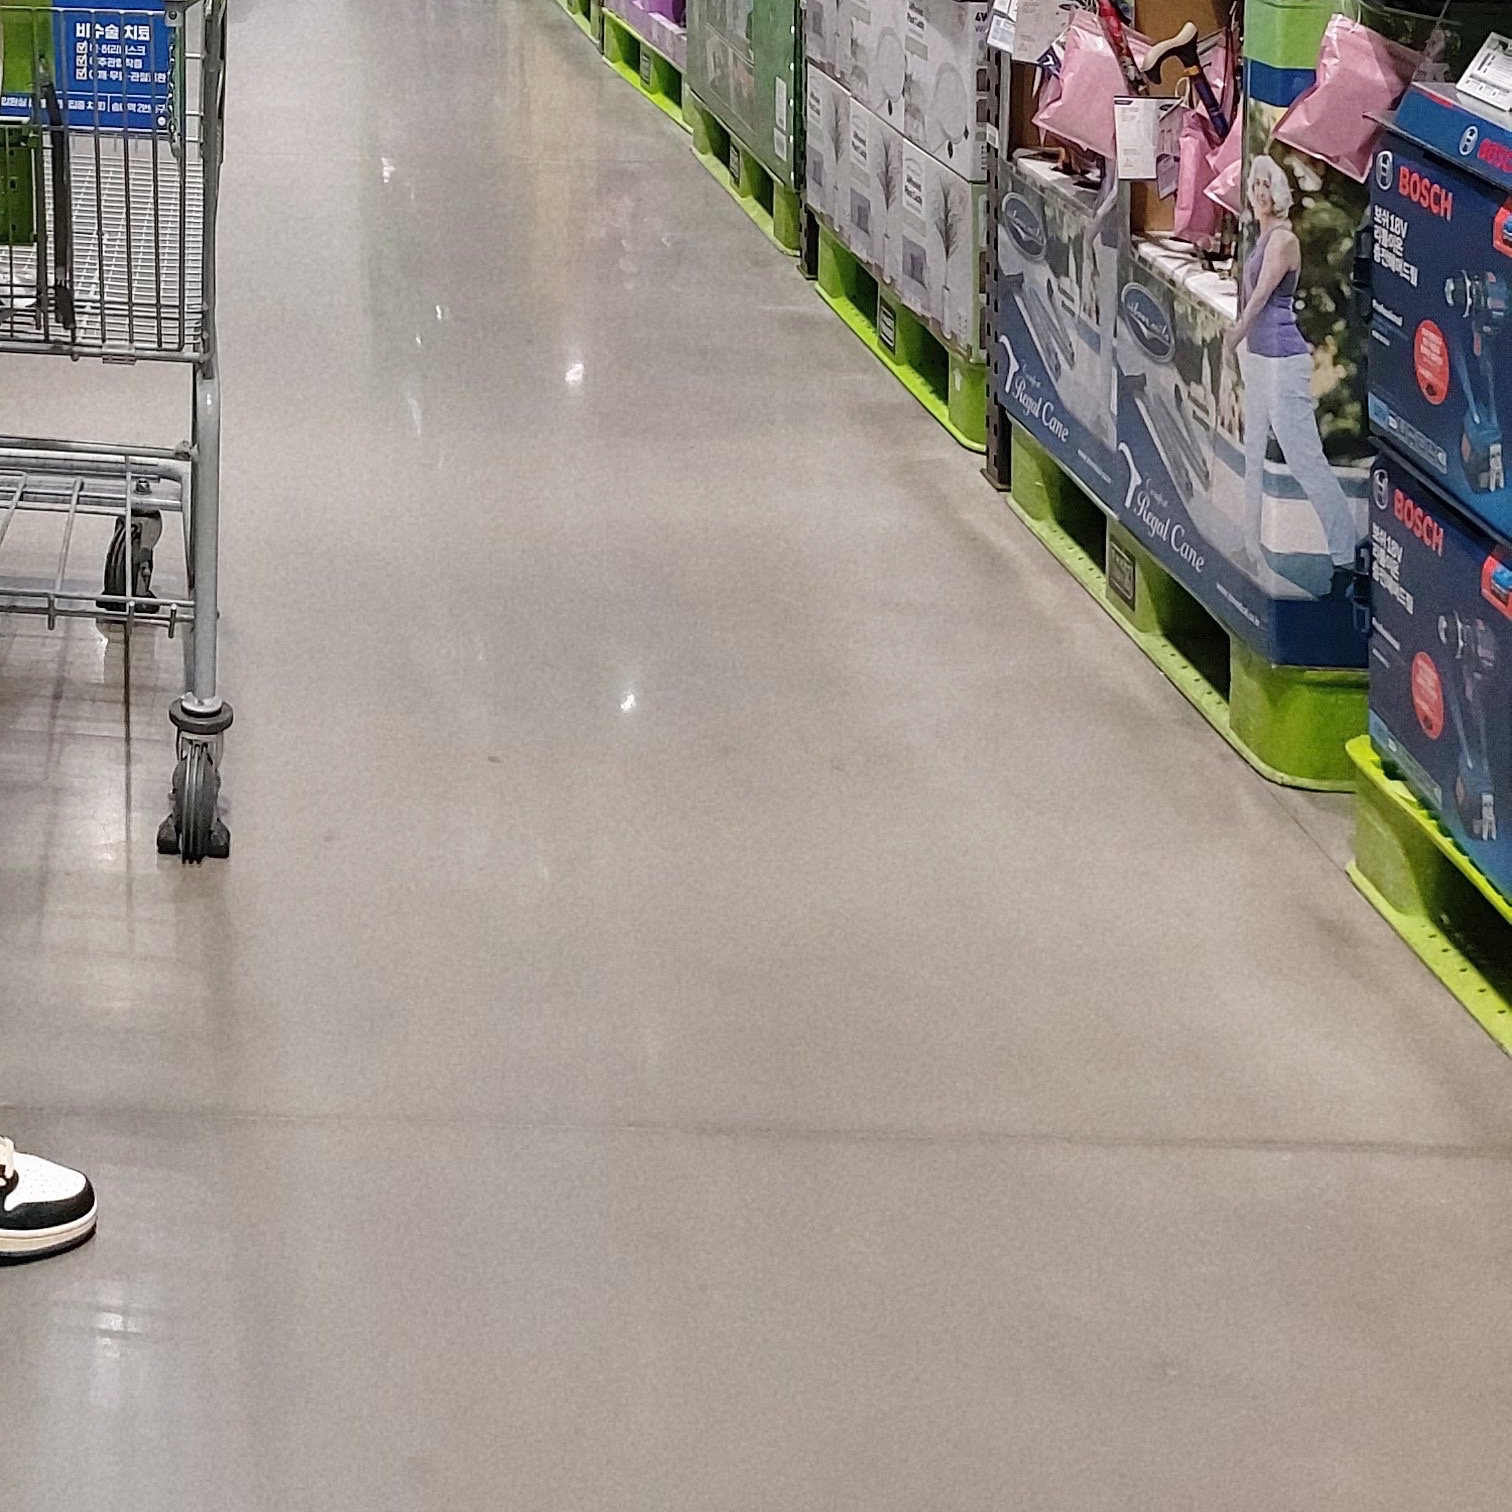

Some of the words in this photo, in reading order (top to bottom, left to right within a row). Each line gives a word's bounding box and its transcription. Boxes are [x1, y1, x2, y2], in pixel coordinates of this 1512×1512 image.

[123, 24, 151, 41] 치료
[1398, 165, 1453, 223] BOSCH
[1390, 212, 1409, 239] 18V
[1013, 382, 1042, 420] Regal
[1042, 401, 1070, 444] Cane
[1135, 496, 1170, 543] Regal
[1170, 523, 1206, 574] Cane
[1393, 488, 1445, 558] BOSCH
